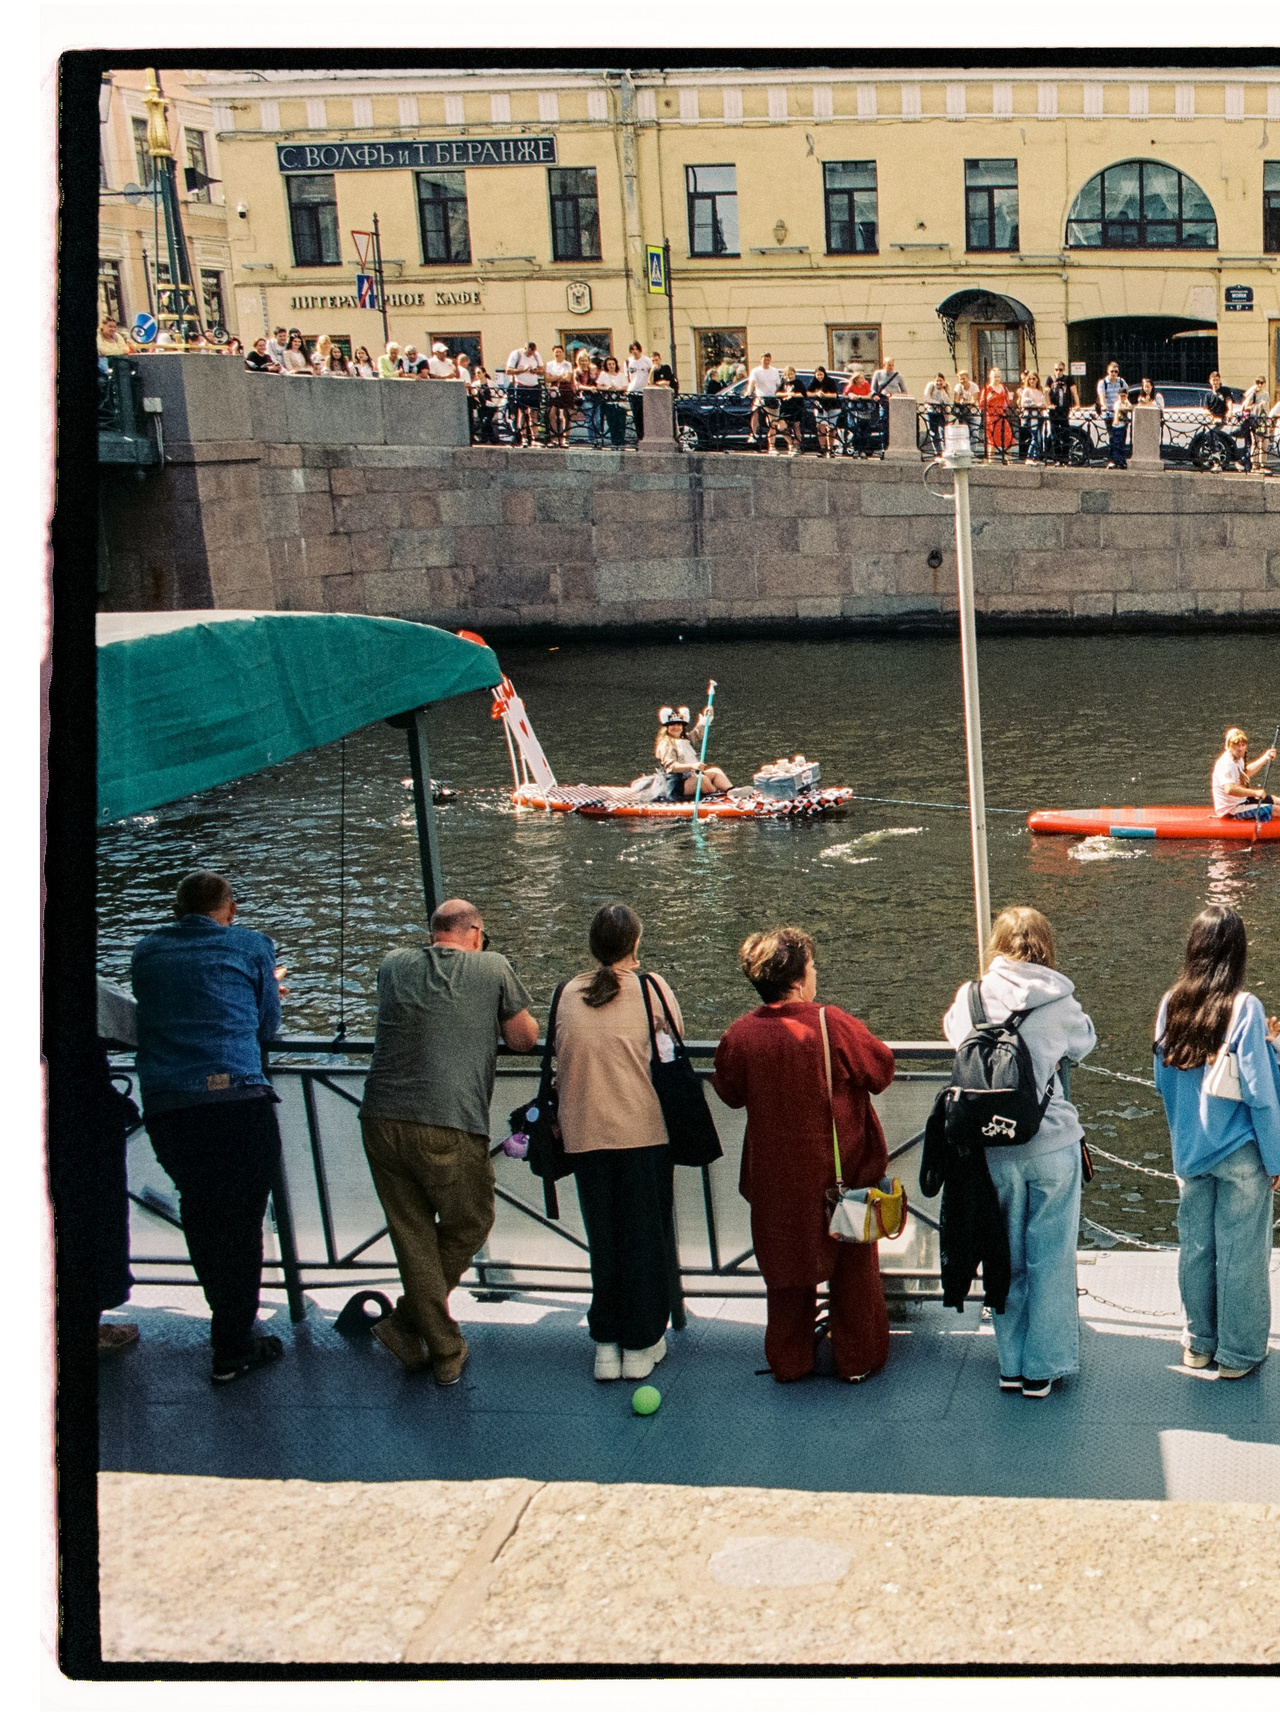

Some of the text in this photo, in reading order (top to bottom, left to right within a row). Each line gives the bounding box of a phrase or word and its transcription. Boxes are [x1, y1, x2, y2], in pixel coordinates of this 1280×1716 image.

[280, 140, 555, 169] С. ВОЛФЪ и Т. БЕРАНЖЕ
[290, 290, 483, 310] ЛИТЕРАРНОЕ КАФЕ
